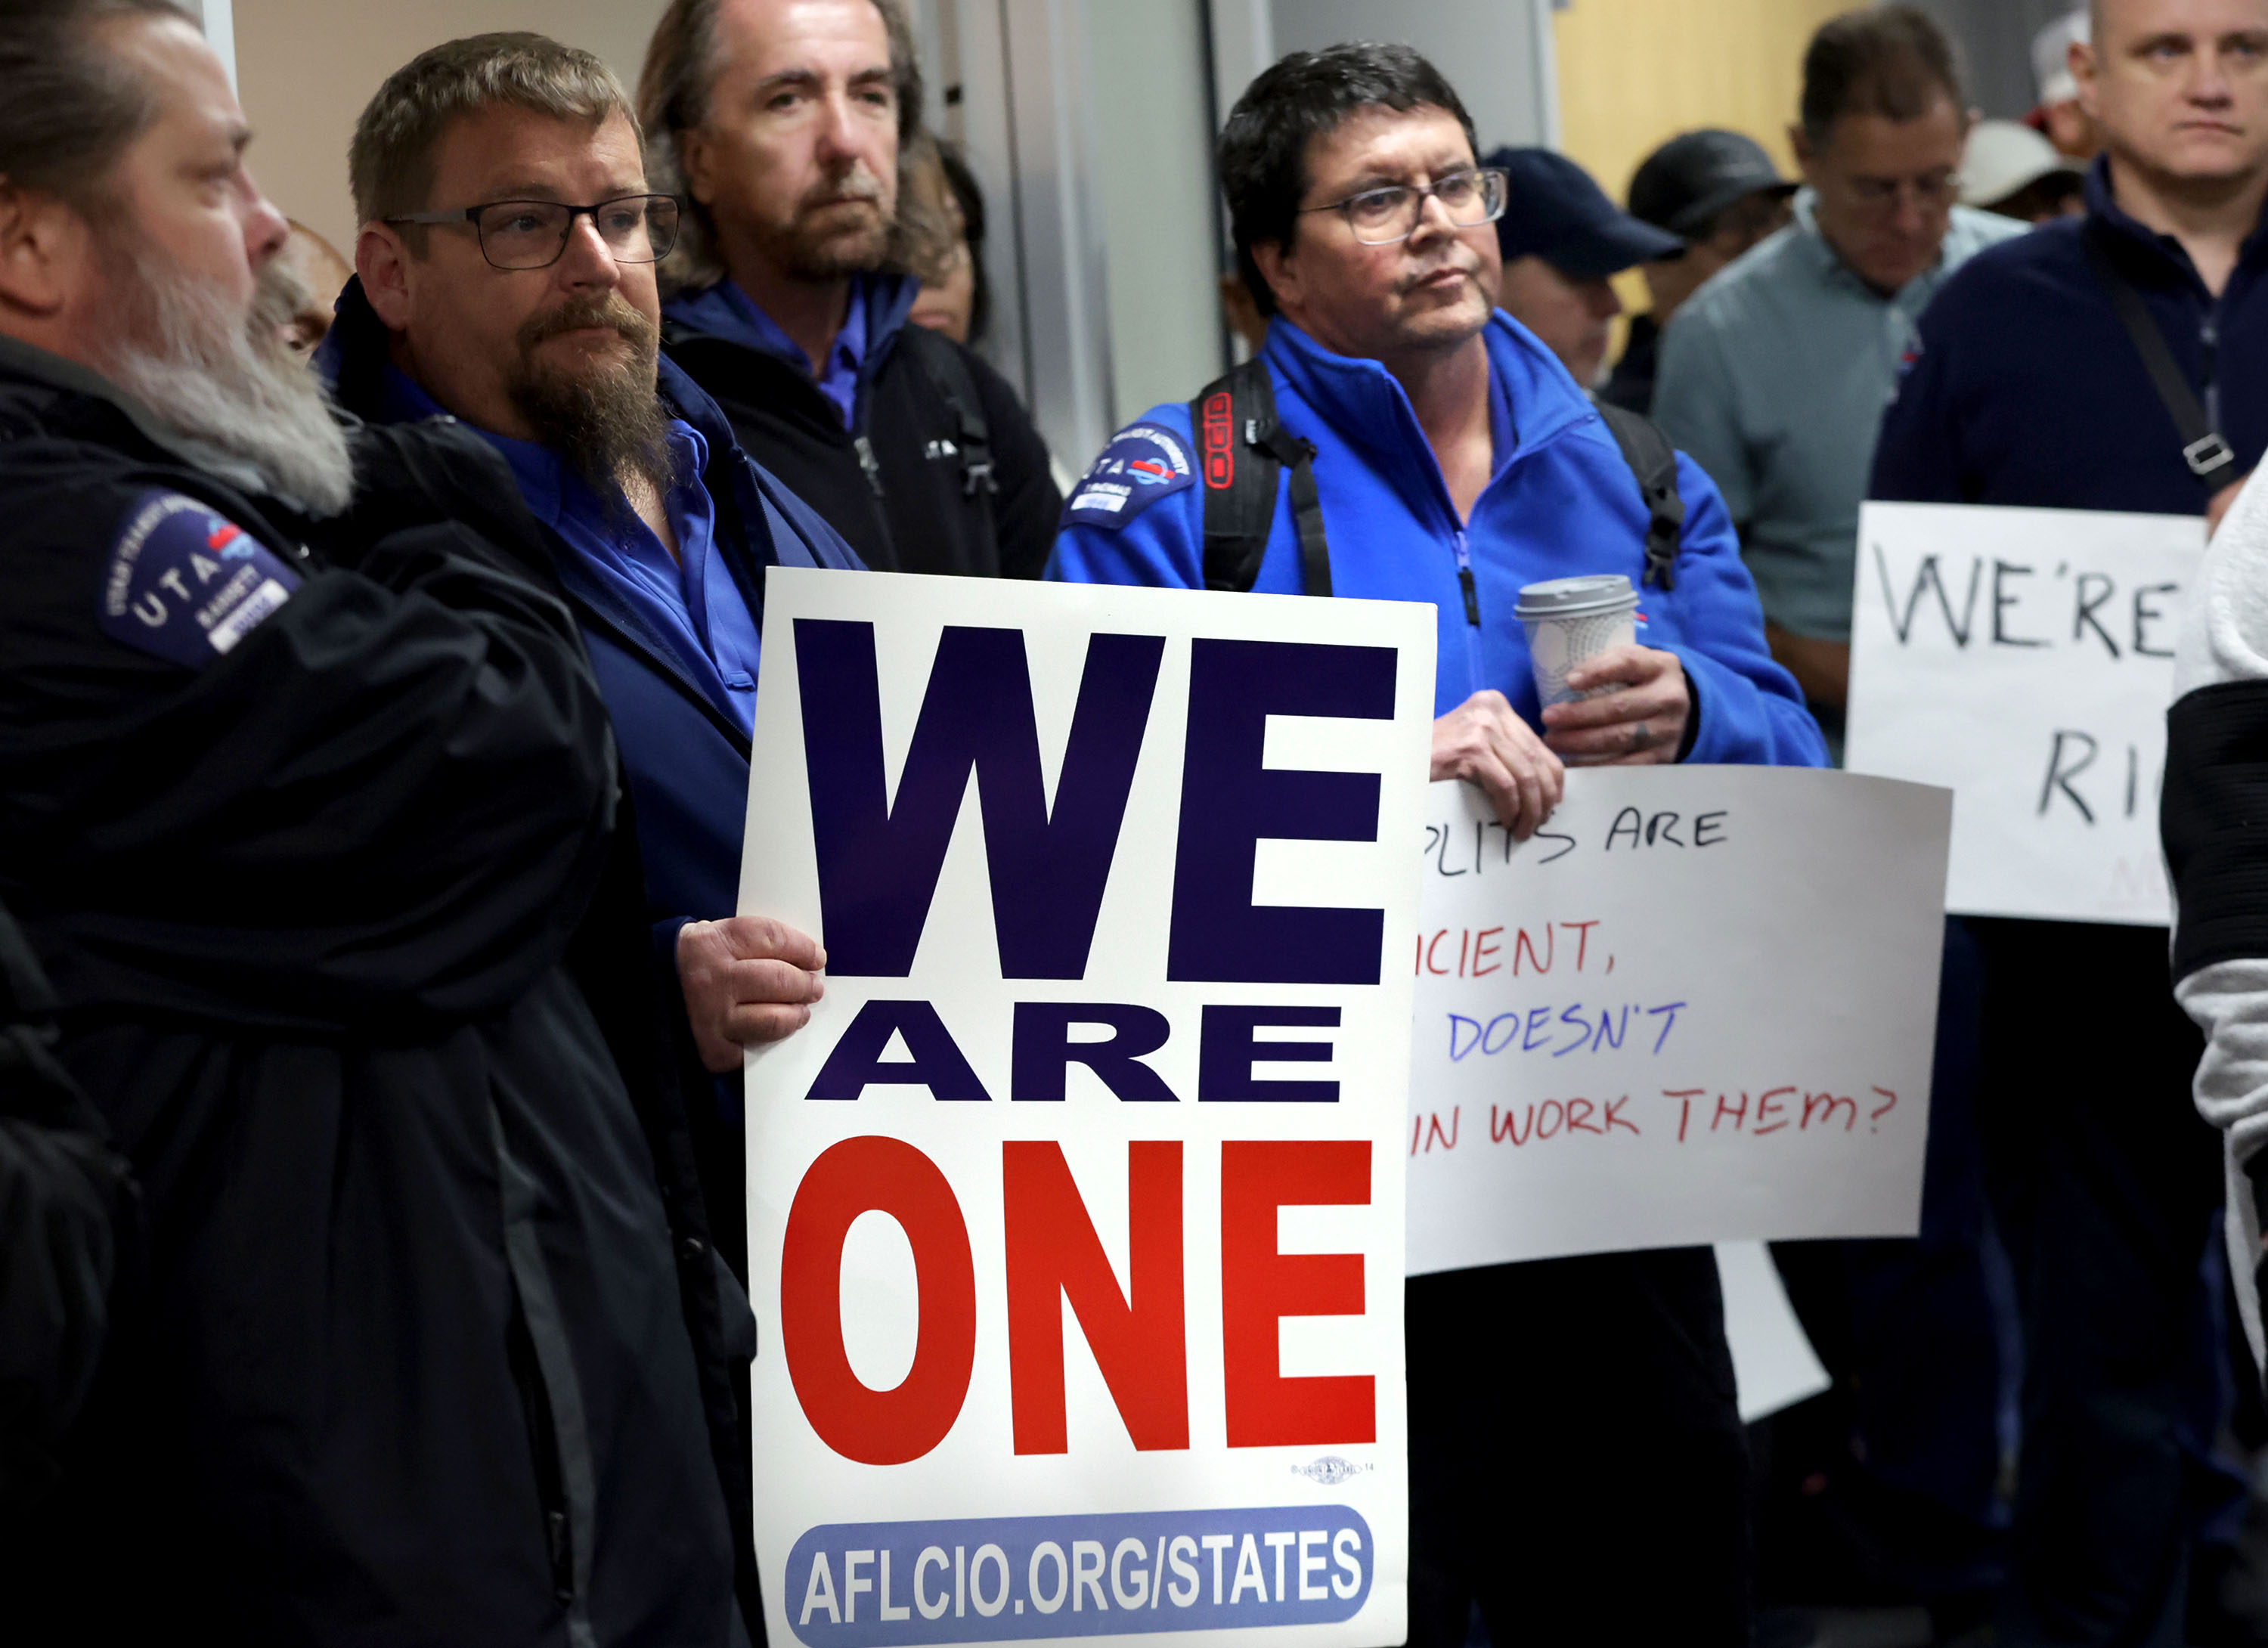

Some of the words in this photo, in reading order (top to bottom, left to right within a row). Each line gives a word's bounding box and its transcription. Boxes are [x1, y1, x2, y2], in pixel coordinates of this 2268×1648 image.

[1204, 392, 1234, 490] OGIO
[133, 553, 221, 627] UTA
[1873, 542, 2179, 661] WE'RE
[792, 618, 1399, 986] WE
[2035, 729, 2164, 828] RI
[1603, 805, 1730, 853] ARE
[804, 999, 1341, 1103] ARE
[1446, 1001, 1688, 1063] DOESN'T
[1489, 1095, 1641, 1148] WORK
[780, 1135, 1377, 1466] ONE
[798, 1528, 1362, 1626] AFLCIO.ORG/STATES
